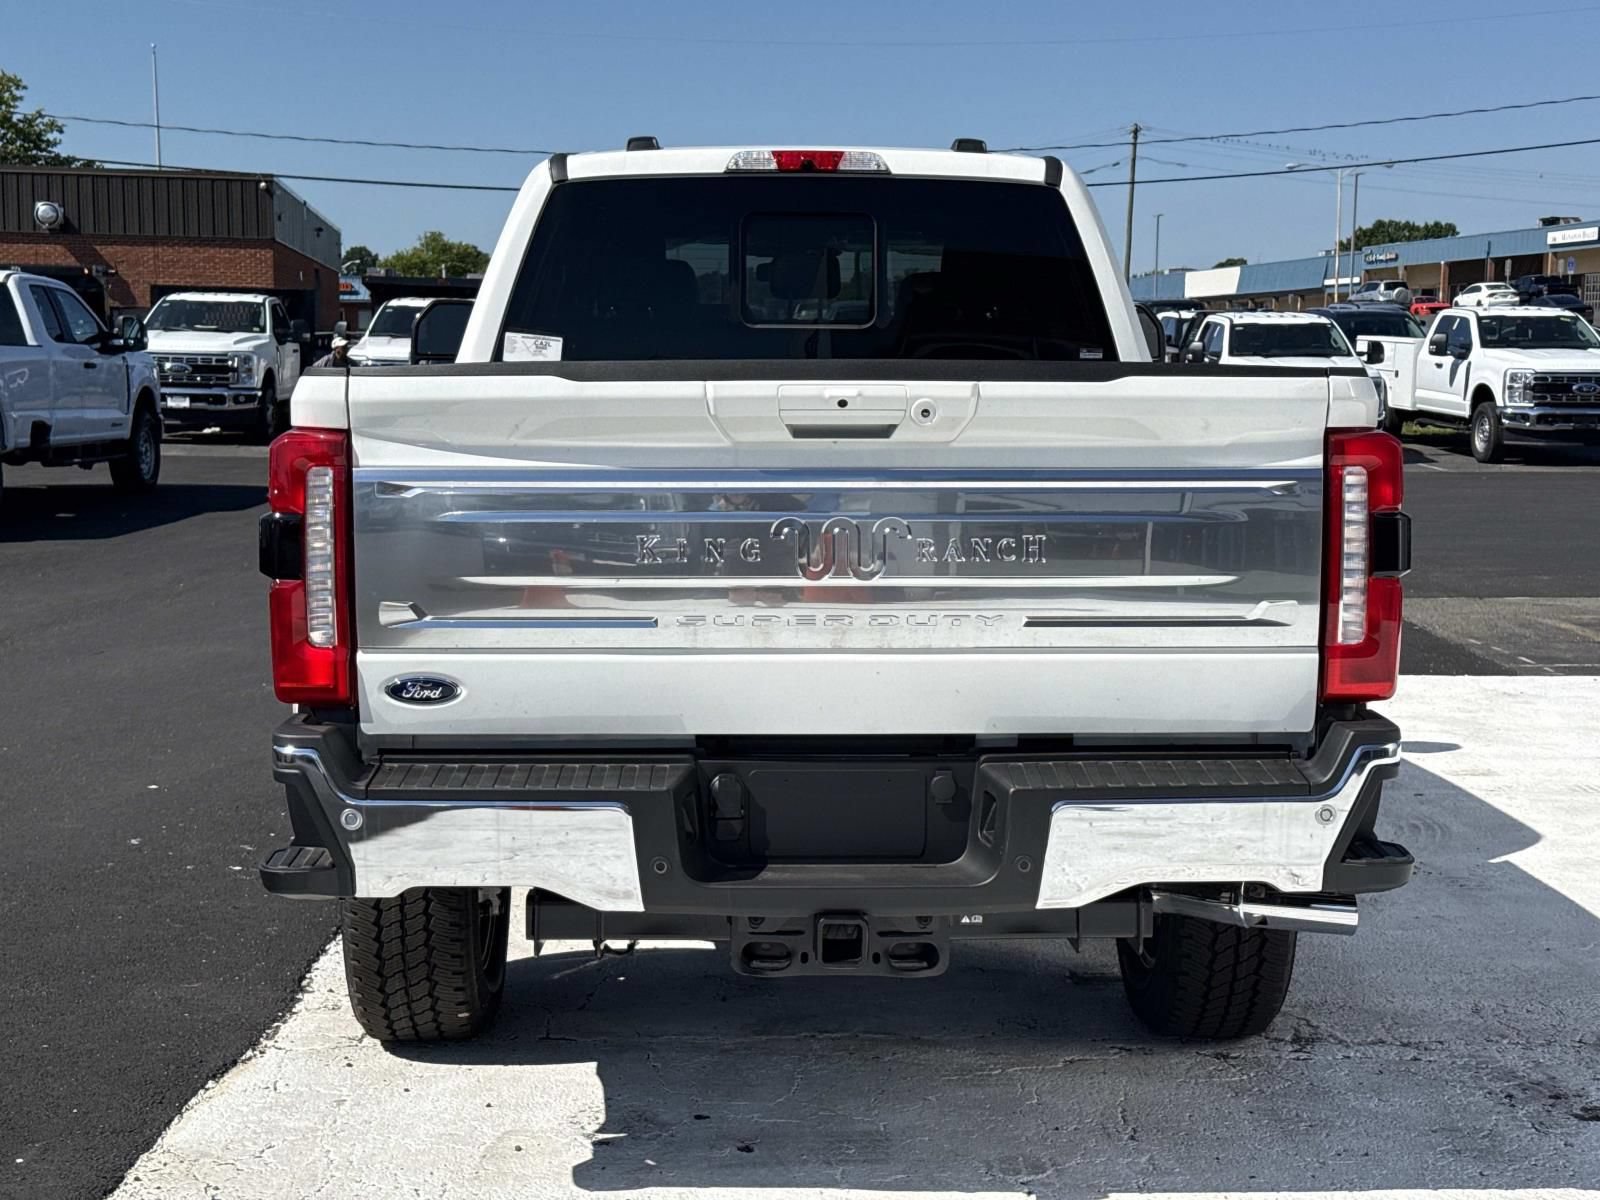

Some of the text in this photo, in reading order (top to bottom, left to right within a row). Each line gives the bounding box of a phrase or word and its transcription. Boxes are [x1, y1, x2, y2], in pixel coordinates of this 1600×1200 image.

[635, 534, 1048, 564] KING RANCH
[676, 613, 1005, 628] SUPER DUTY
[401, 680, 443, 698] Ford
